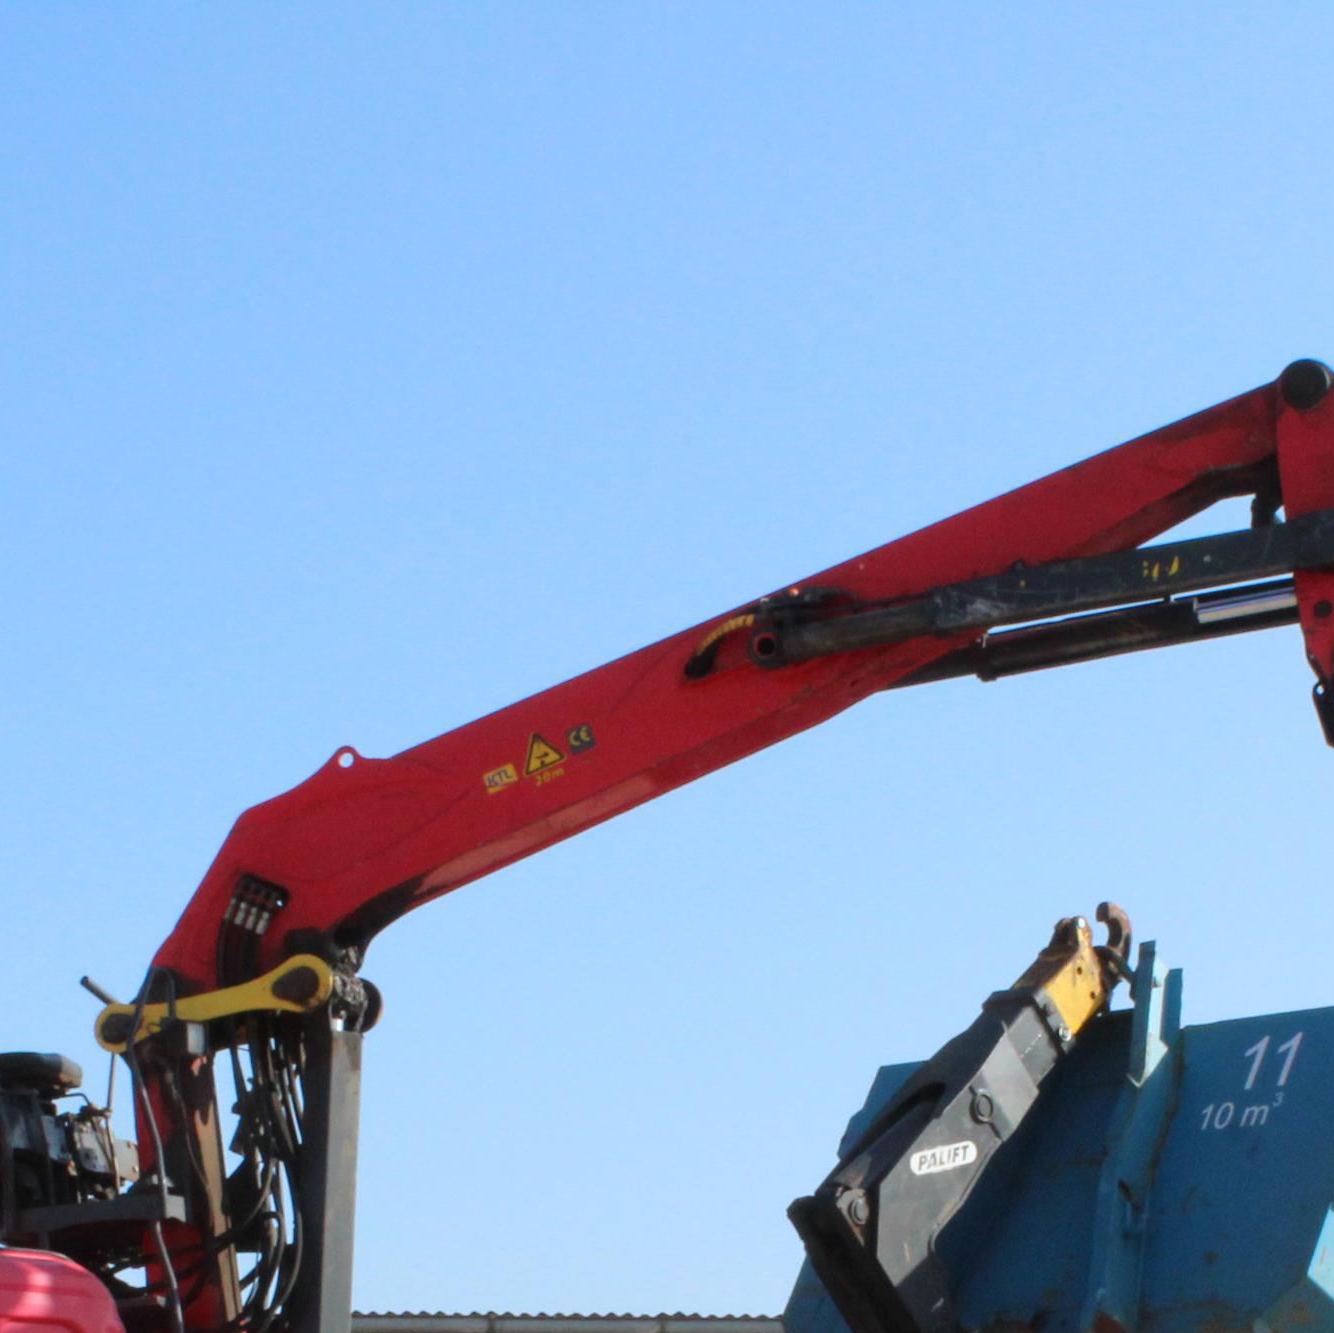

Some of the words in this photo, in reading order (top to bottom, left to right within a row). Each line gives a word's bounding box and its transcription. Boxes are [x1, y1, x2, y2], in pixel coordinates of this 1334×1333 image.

[1244, 1032, 1303, 1090] 11
[1201, 1103, 1234, 1131] 10
[918, 1145, 969, 1172] PALIFT
